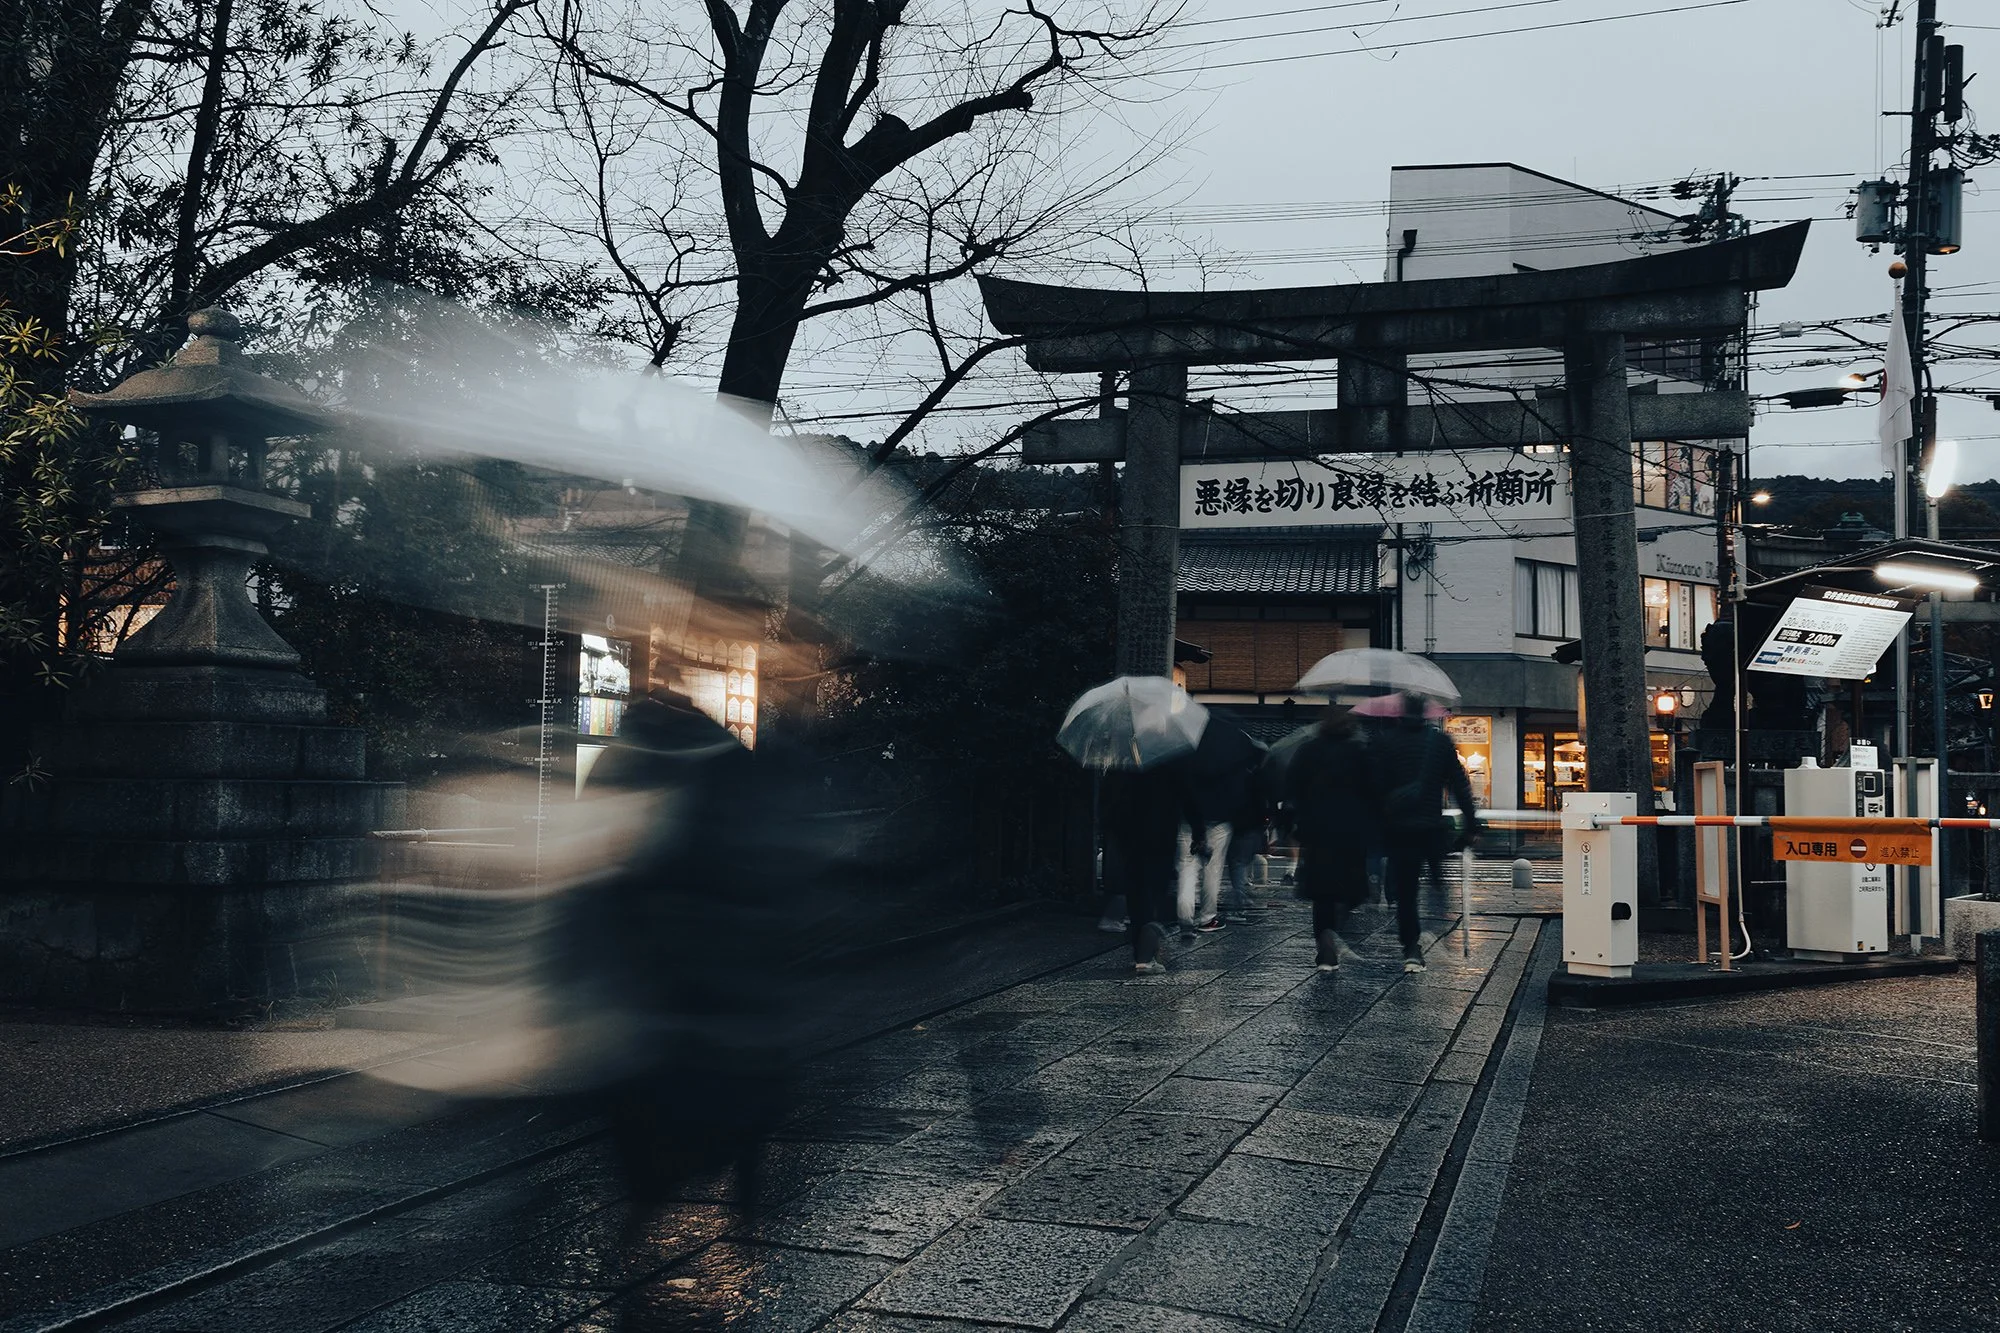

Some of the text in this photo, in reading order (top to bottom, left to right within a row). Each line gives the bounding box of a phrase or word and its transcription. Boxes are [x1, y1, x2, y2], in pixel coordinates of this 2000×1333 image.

[1194, 468, 1556, 516] 悪縁を切り良縁を結ぶ祈願所
[1656, 554, 1703, 578] Kimono
[1805, 632, 1837, 646] 2,000円
[1785, 840, 1837, 857] 入口専用
[1879, 845, 1920, 859] 進入禁止
